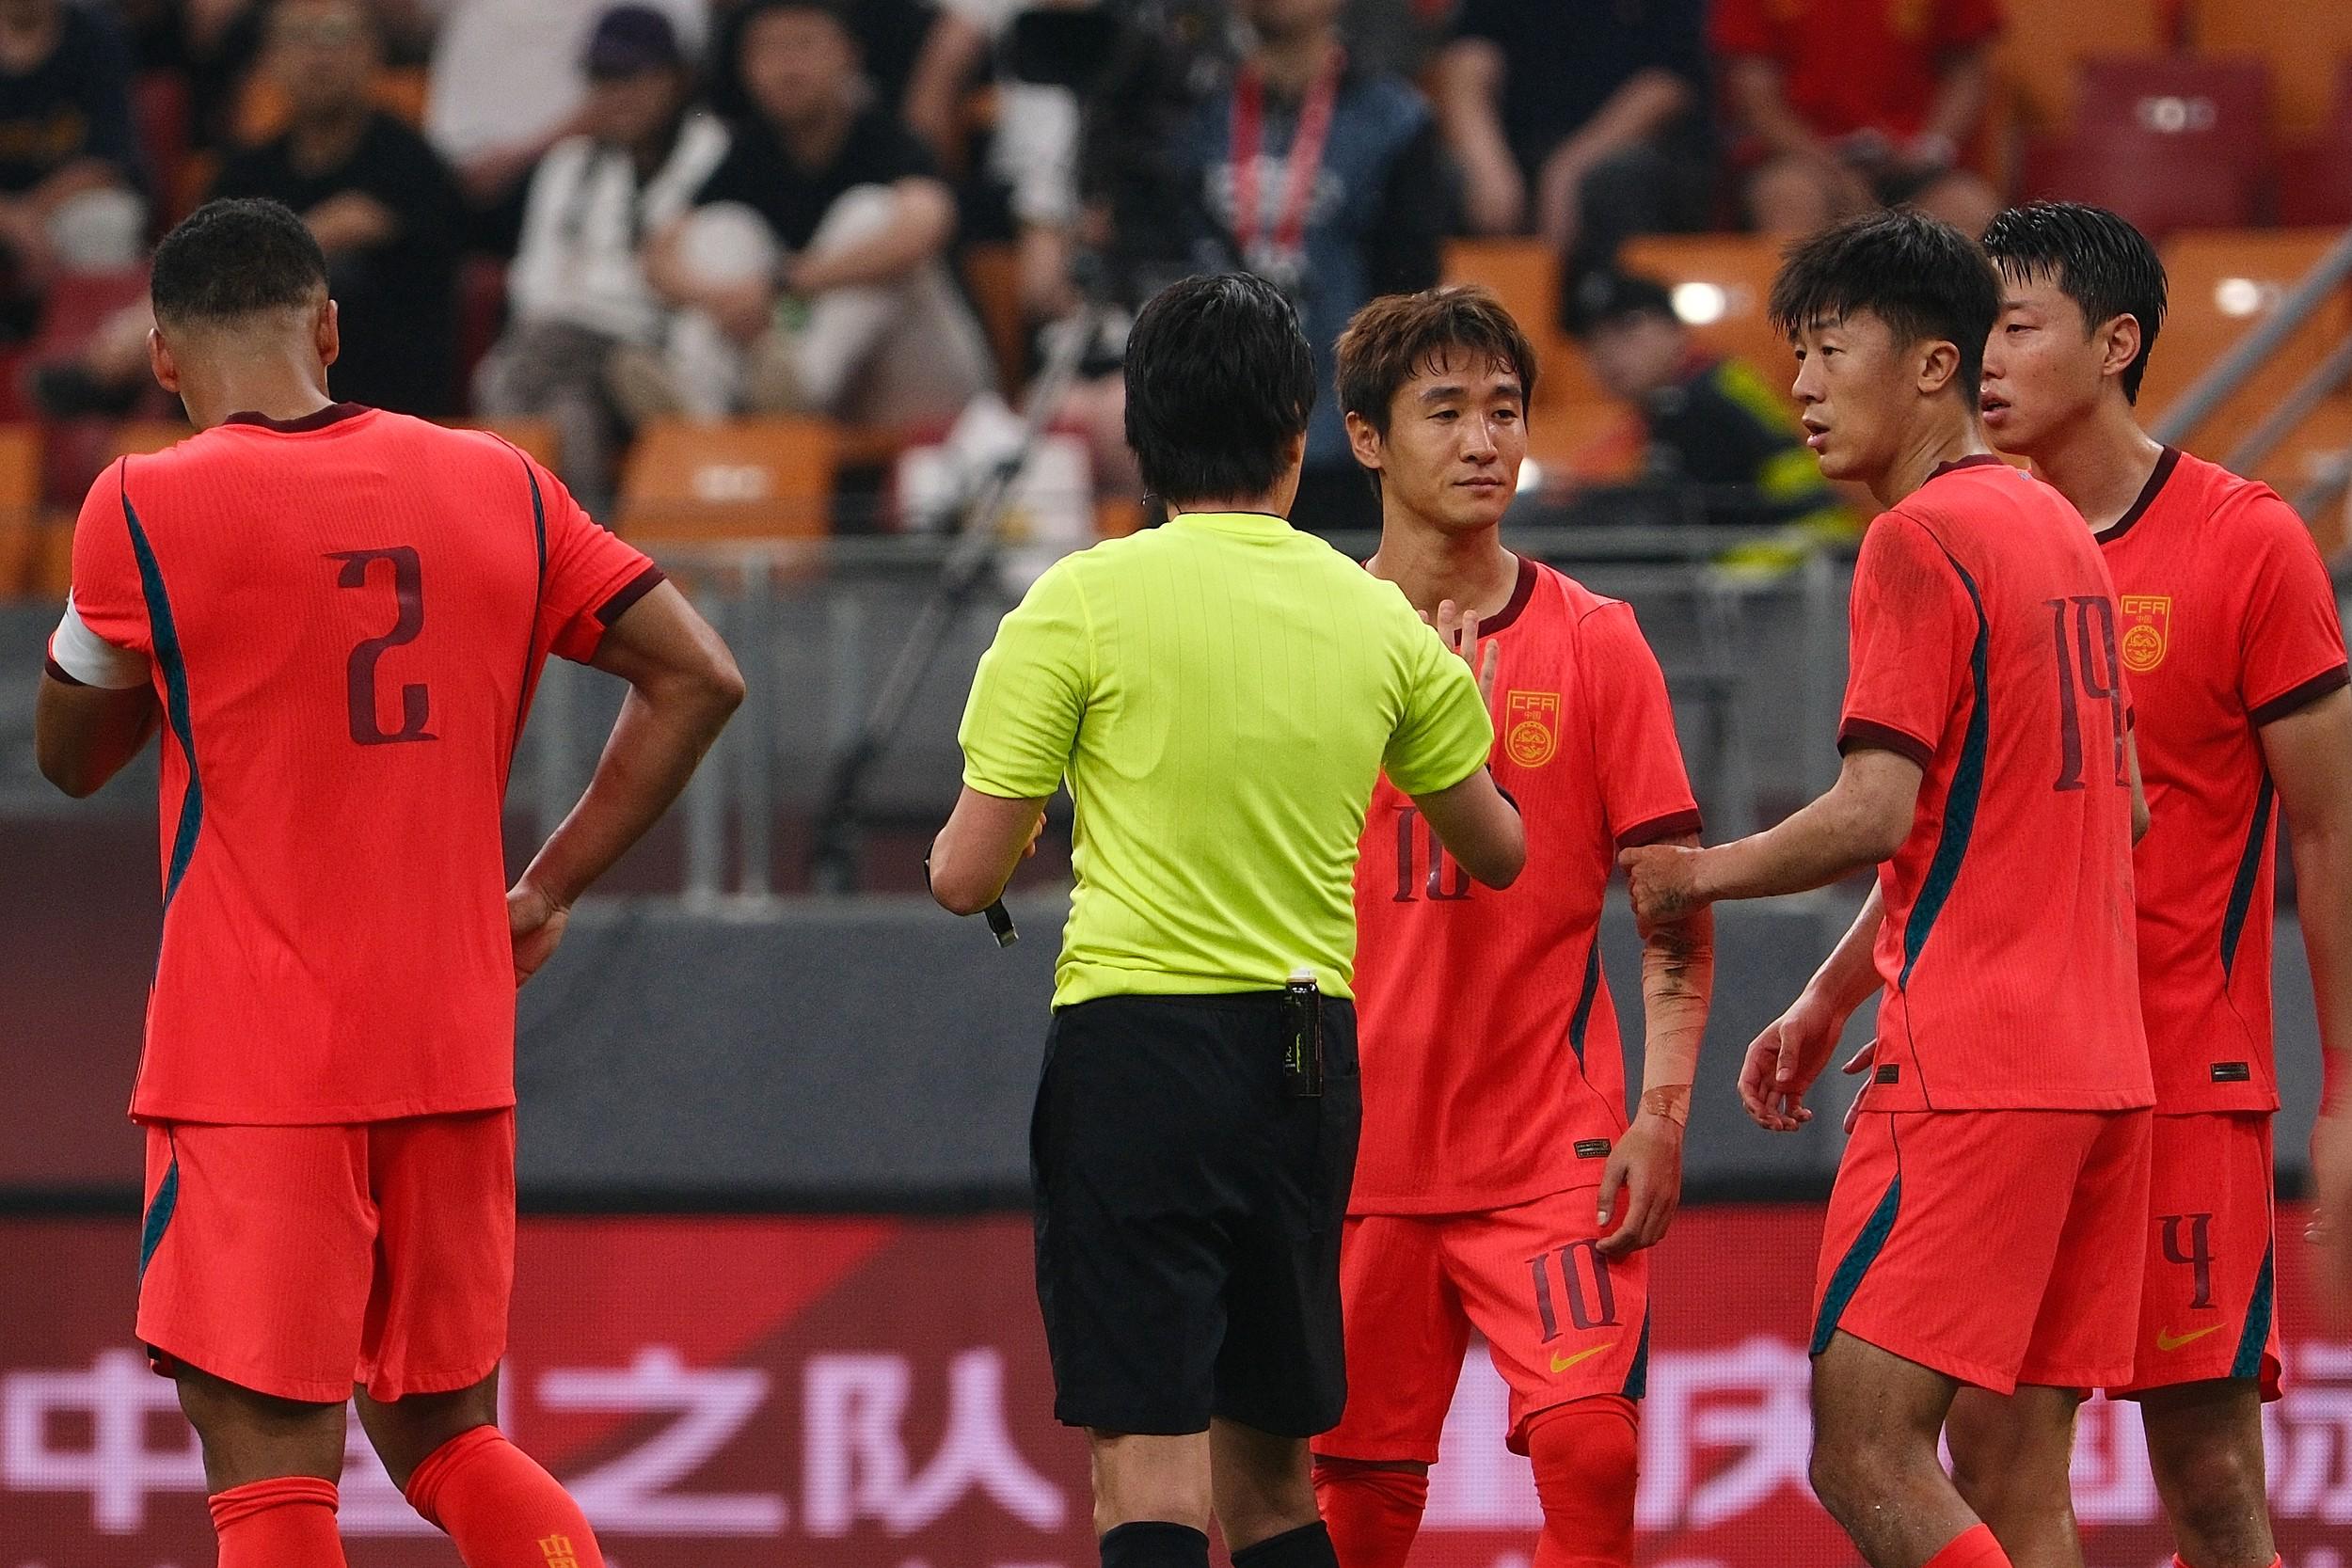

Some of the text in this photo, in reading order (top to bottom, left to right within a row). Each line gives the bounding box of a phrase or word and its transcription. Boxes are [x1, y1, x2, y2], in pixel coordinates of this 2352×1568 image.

[321, 546, 439, 745] 2
[2125, 601, 2166, 615] CFA
[1512, 696, 1555, 711] CFA
[2042, 595, 2131, 791] 19
[1524, 1238, 1625, 1345] 10
[2154, 1212, 2217, 1309] 4
